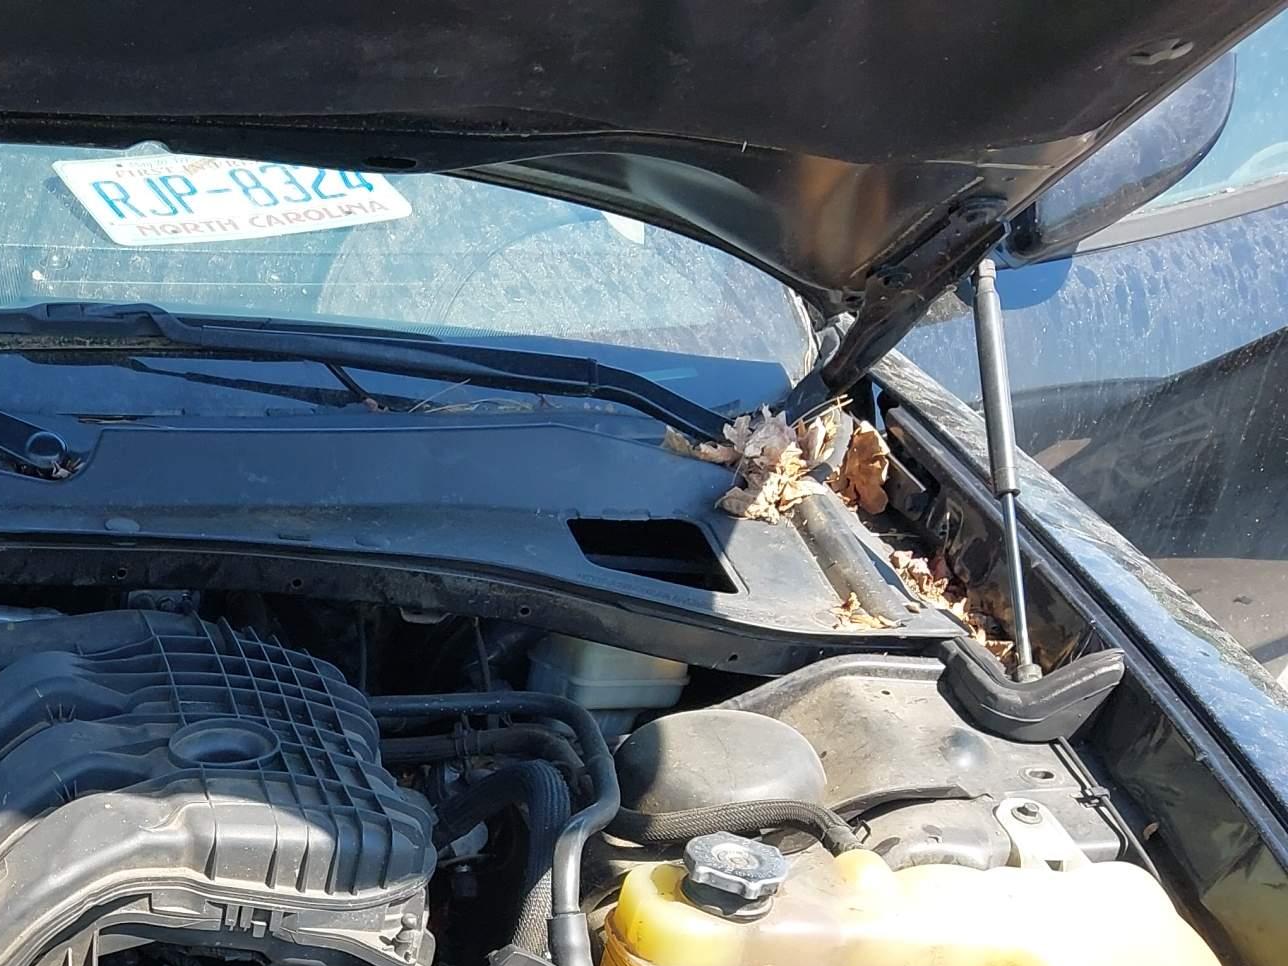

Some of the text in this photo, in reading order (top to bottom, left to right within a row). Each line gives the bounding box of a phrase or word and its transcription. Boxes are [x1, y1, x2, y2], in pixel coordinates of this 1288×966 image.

[91, 165, 374, 219] RJP-8324
[137, 200, 390, 237] NORTH CAROLINA
